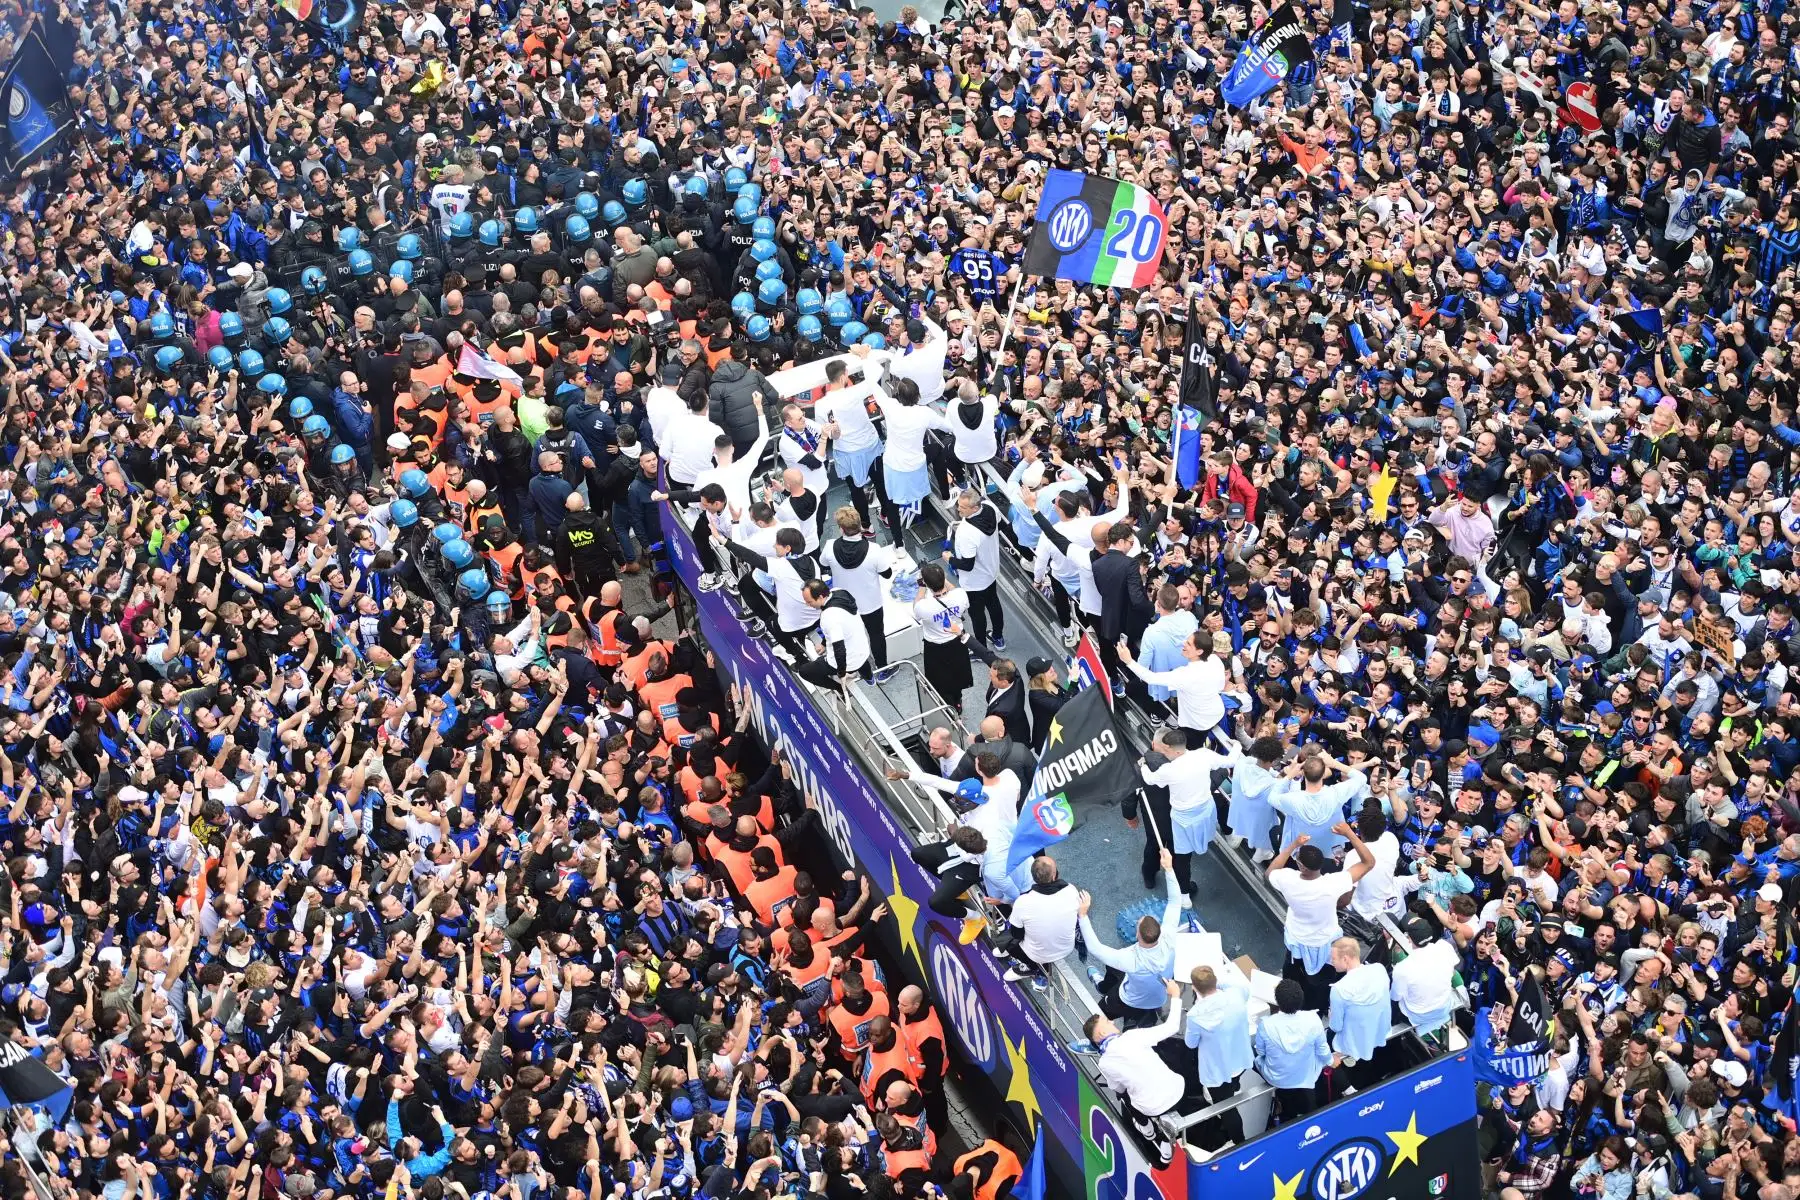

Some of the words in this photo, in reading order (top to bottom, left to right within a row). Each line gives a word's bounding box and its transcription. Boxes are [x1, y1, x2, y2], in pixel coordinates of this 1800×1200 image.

[740, 210, 756, 218] POLIZIA
[1105, 208, 1163, 264] 20
[963, 259, 993, 281] 95
[803, 327, 821, 336] POLIZIA
[568, 530, 593, 542] MKS
[933, 605, 960, 623] INTER
[1358, 1100, 1384, 1117] ebay
[1430, 1176, 1445, 1191] 20
